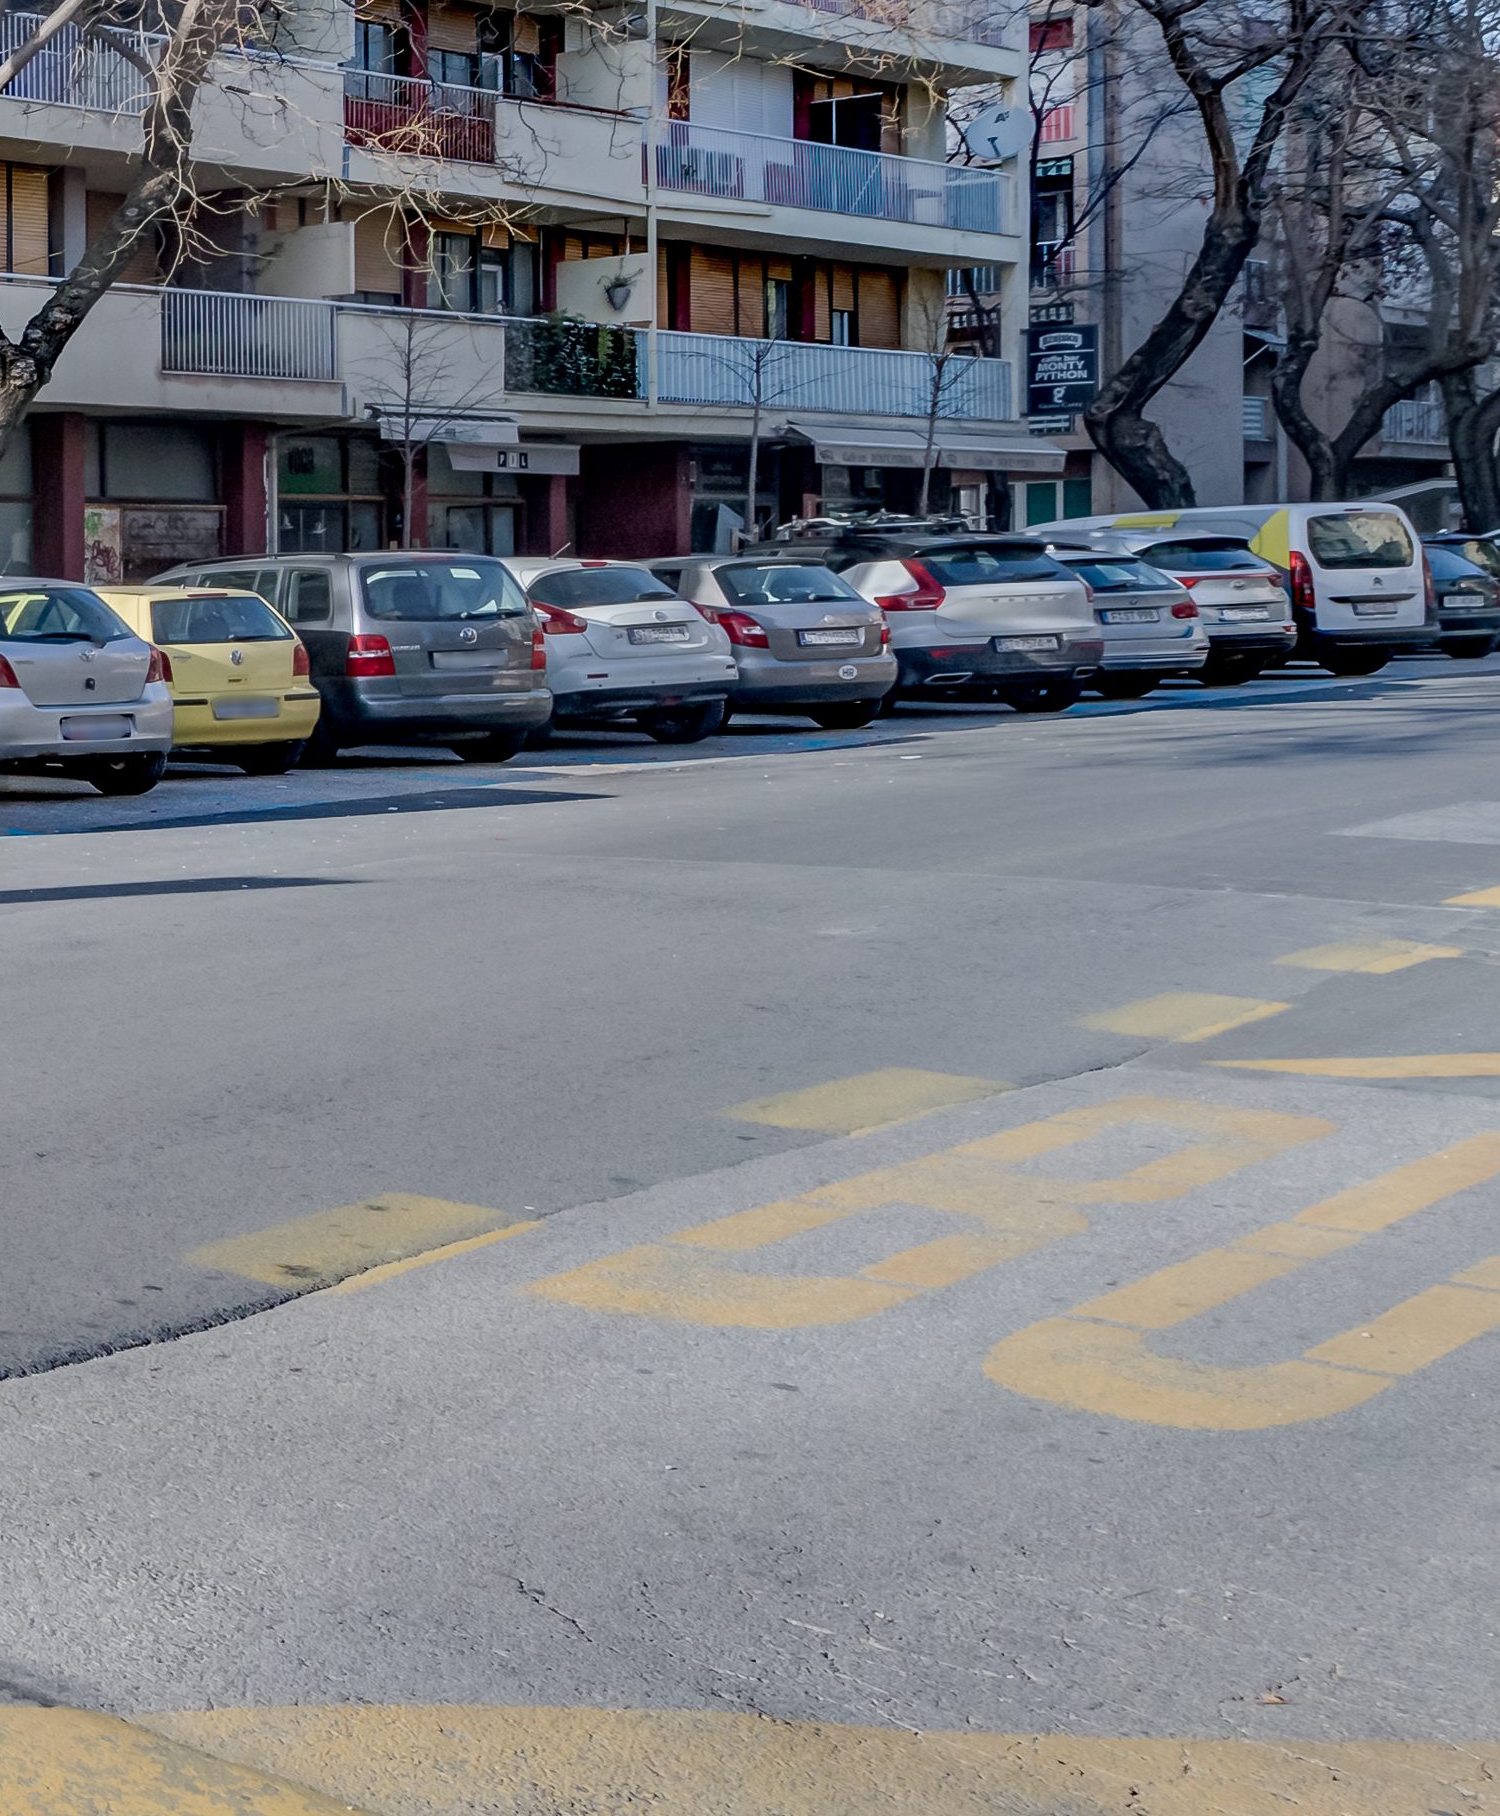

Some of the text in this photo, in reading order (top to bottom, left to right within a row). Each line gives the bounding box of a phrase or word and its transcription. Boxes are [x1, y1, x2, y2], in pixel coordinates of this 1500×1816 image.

[1038, 360, 1085, 371] MONTY
[1035, 370, 1088, 382] PYTHON
[842, 668, 855, 677] HR
